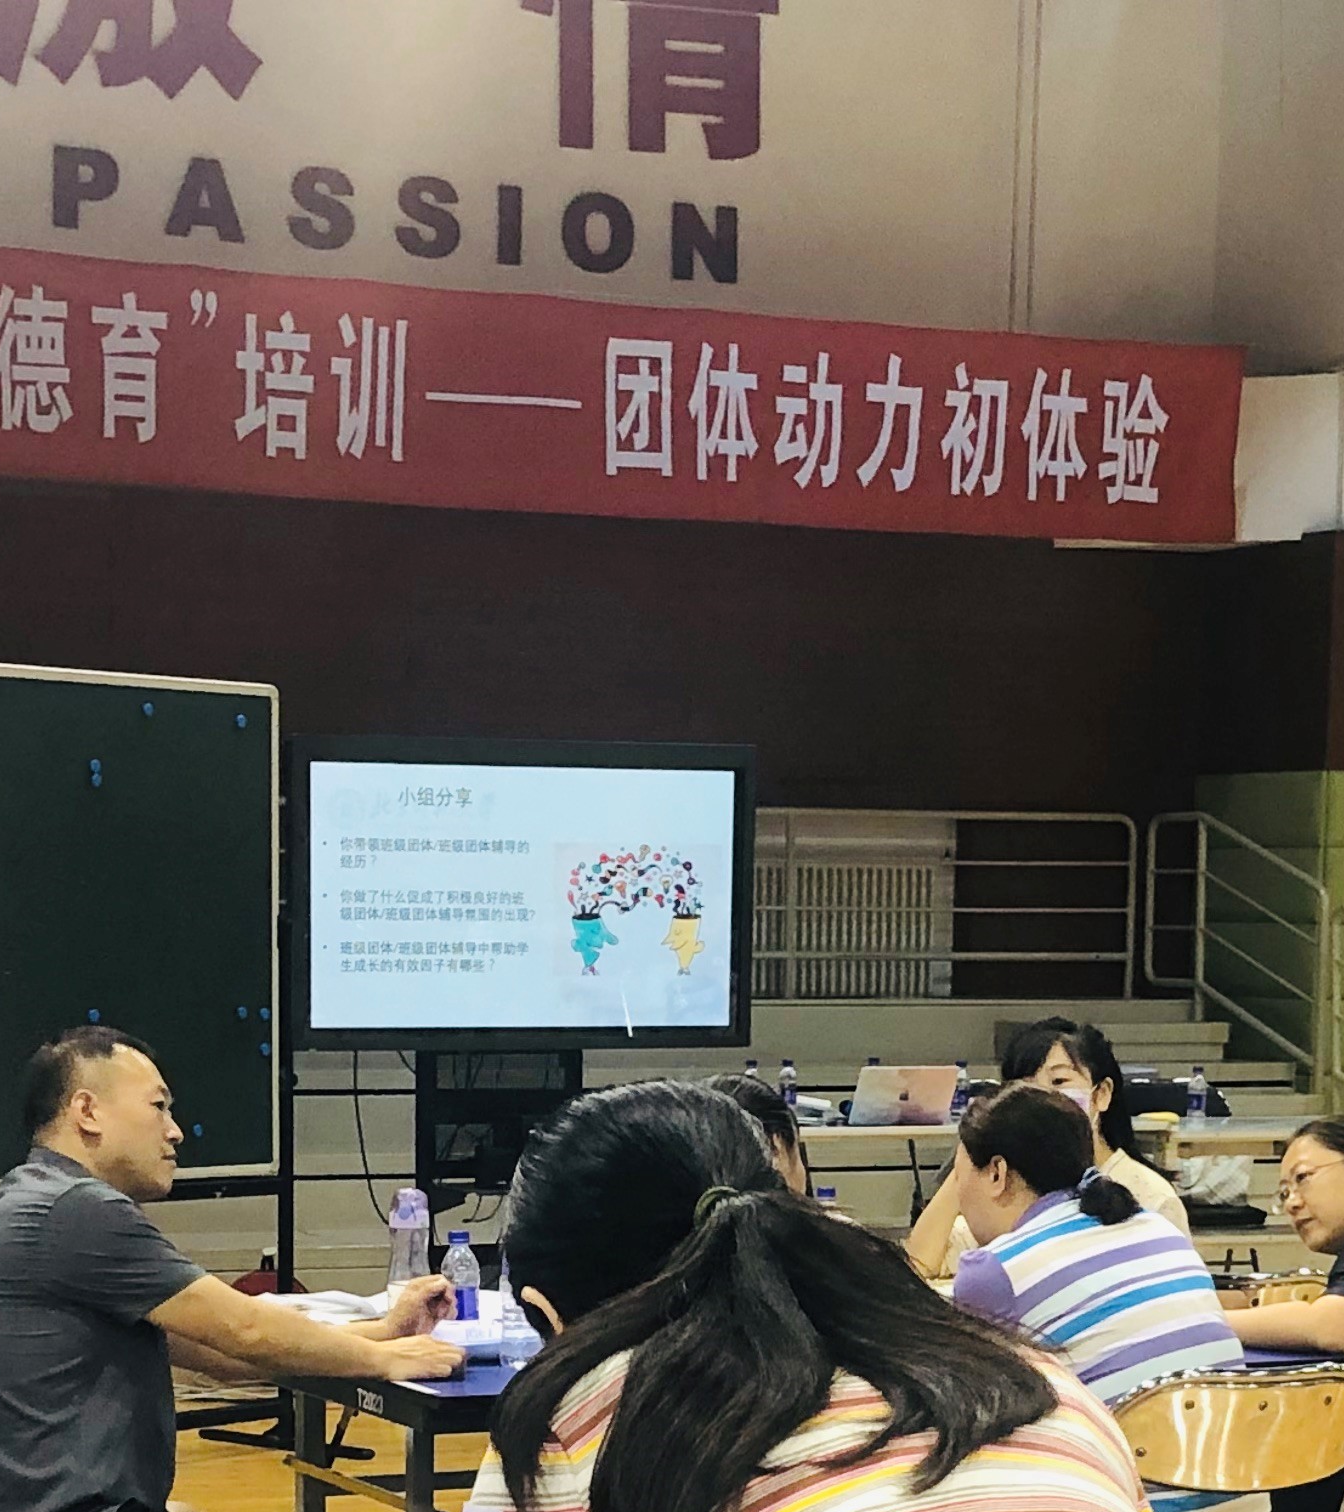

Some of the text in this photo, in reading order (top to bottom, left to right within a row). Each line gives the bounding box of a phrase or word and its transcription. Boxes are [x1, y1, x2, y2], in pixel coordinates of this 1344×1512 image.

[51, 143, 739, 285] PASSION
[398, 786, 473, 808] 小组分享
